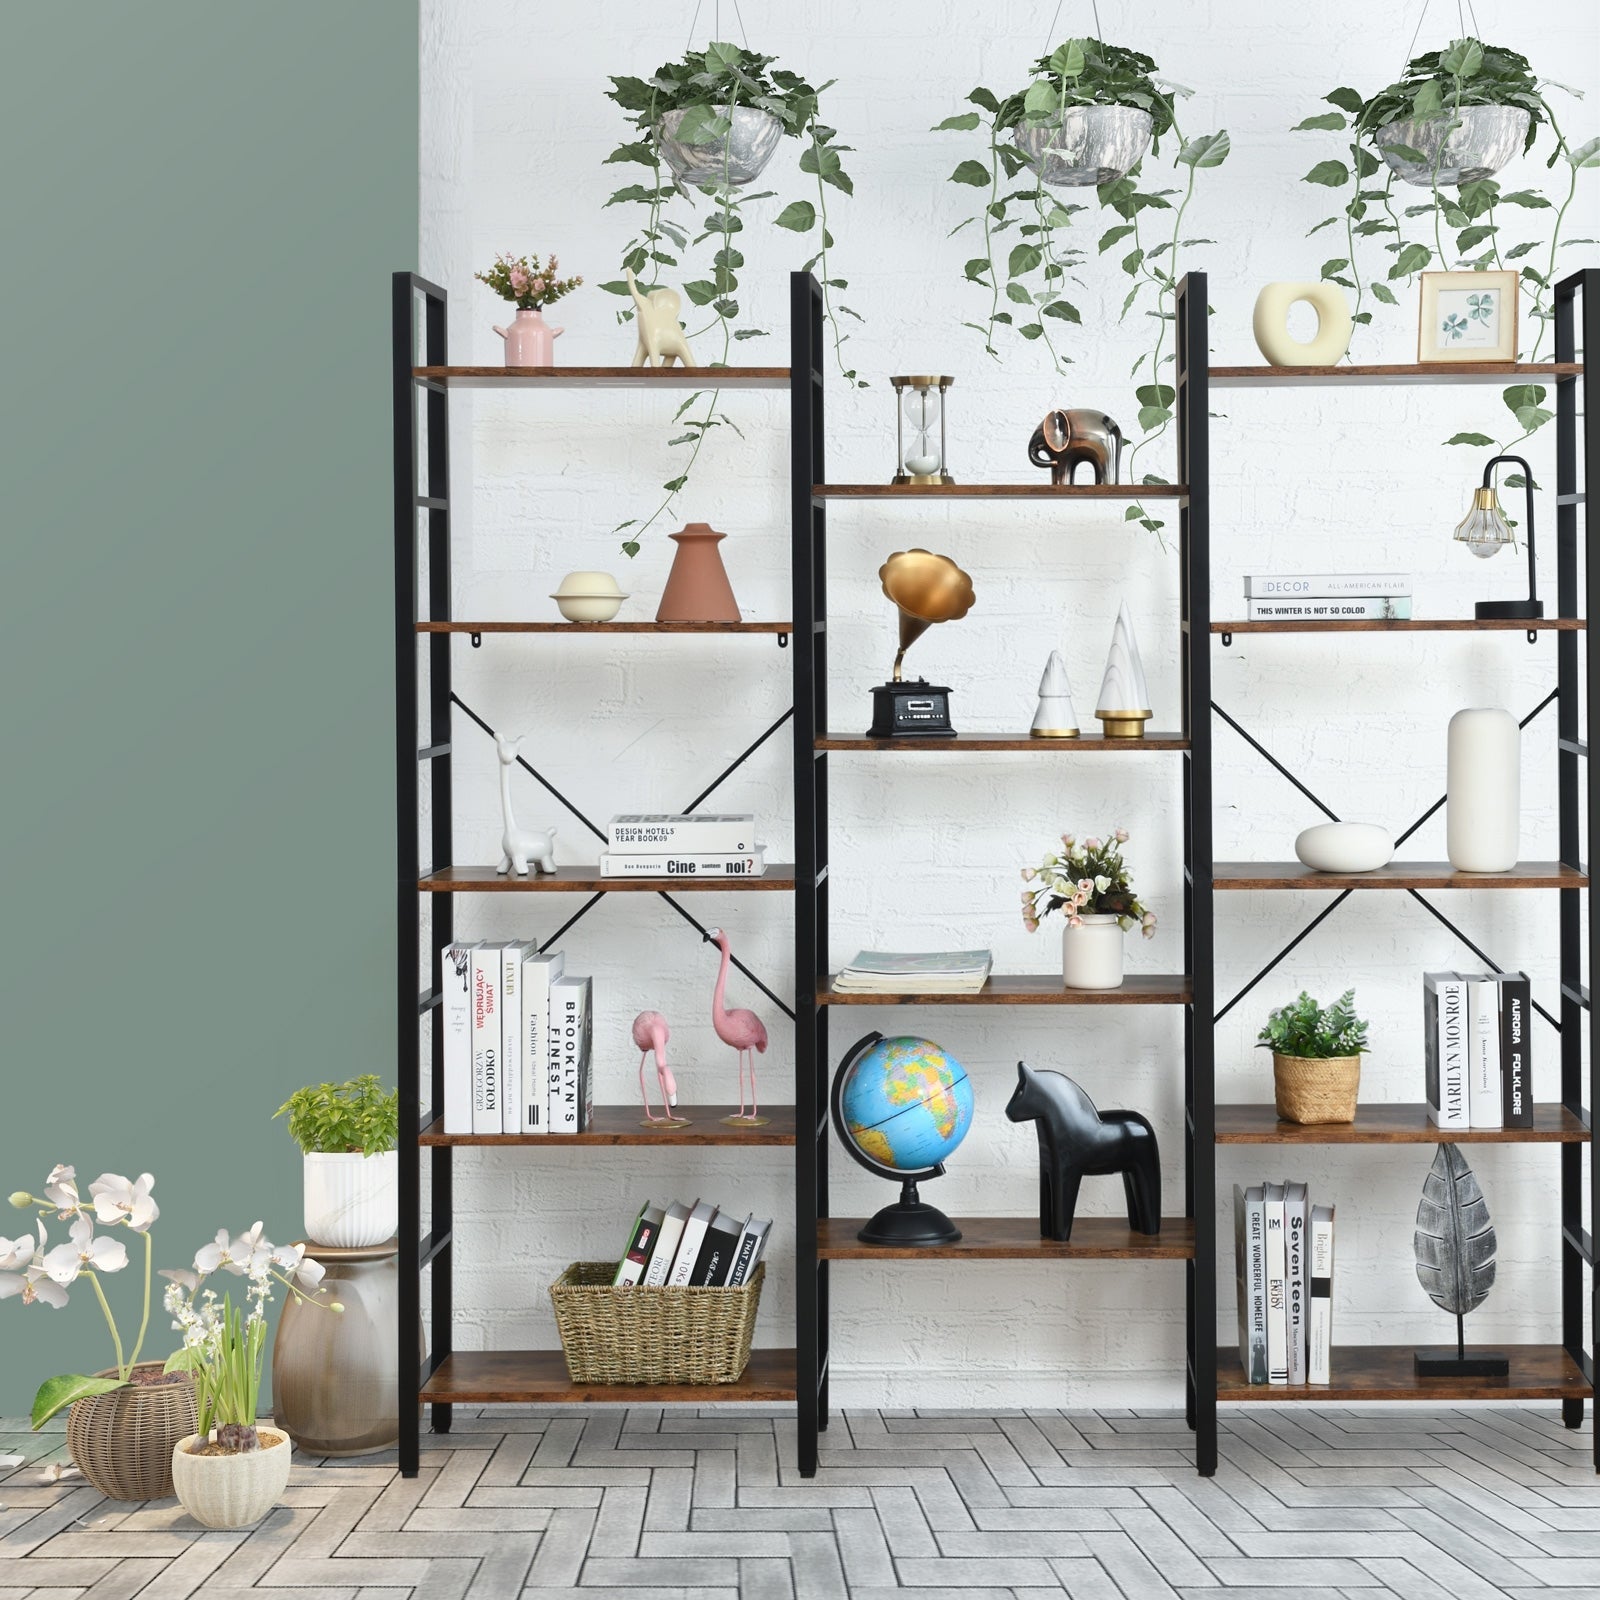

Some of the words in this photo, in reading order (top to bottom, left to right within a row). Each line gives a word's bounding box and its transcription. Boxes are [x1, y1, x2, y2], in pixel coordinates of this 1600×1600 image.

[1267, 581, 1310, 592] DECOR
[1327, 582, 1382, 590] ALL-AMERICAN
[1256, 607, 1273, 615] THIS
[1275, 607, 1303, 615] WINTER
[1304, 607, 1312, 615] IS
[1314, 607, 1328, 615] NOT
[1330, 607, 1340, 615] SO
[615, 827, 643, 835] DESIGN
[645, 827, 675, 835] HOTELS
[667, 860, 696, 874] Cine
[725, 858, 754, 874] noi?
[505, 961, 515, 997] LUXURY
[486, 983, 494, 1014] ŚWIAT
[1445, 984, 1461, 1049] MONROE
[530, 1013, 538, 1056] Fashion
[1511, 998, 1521, 1045] AURORA
[486, 1049, 496, 1111] KOŁODKO
[550, 1028, 561, 1096] FINEST
[564, 1001, 576, 1123] BROOKLYN'S
[1446, 1052, 1462, 1120] MARILYN
[1512, 1053, 1522, 1116] FOLKLORE
[1251, 1211, 1261, 1241] CREATE
[742, 1238, 754, 1260] THAT
[1252, 1244, 1262, 1292] WONDERFUL
[1315, 1233, 1328, 1271] Brightest
[1270, 1279, 1280, 1310] ENJOY
[1253, 1295, 1264, 1333] HOMELIFE
